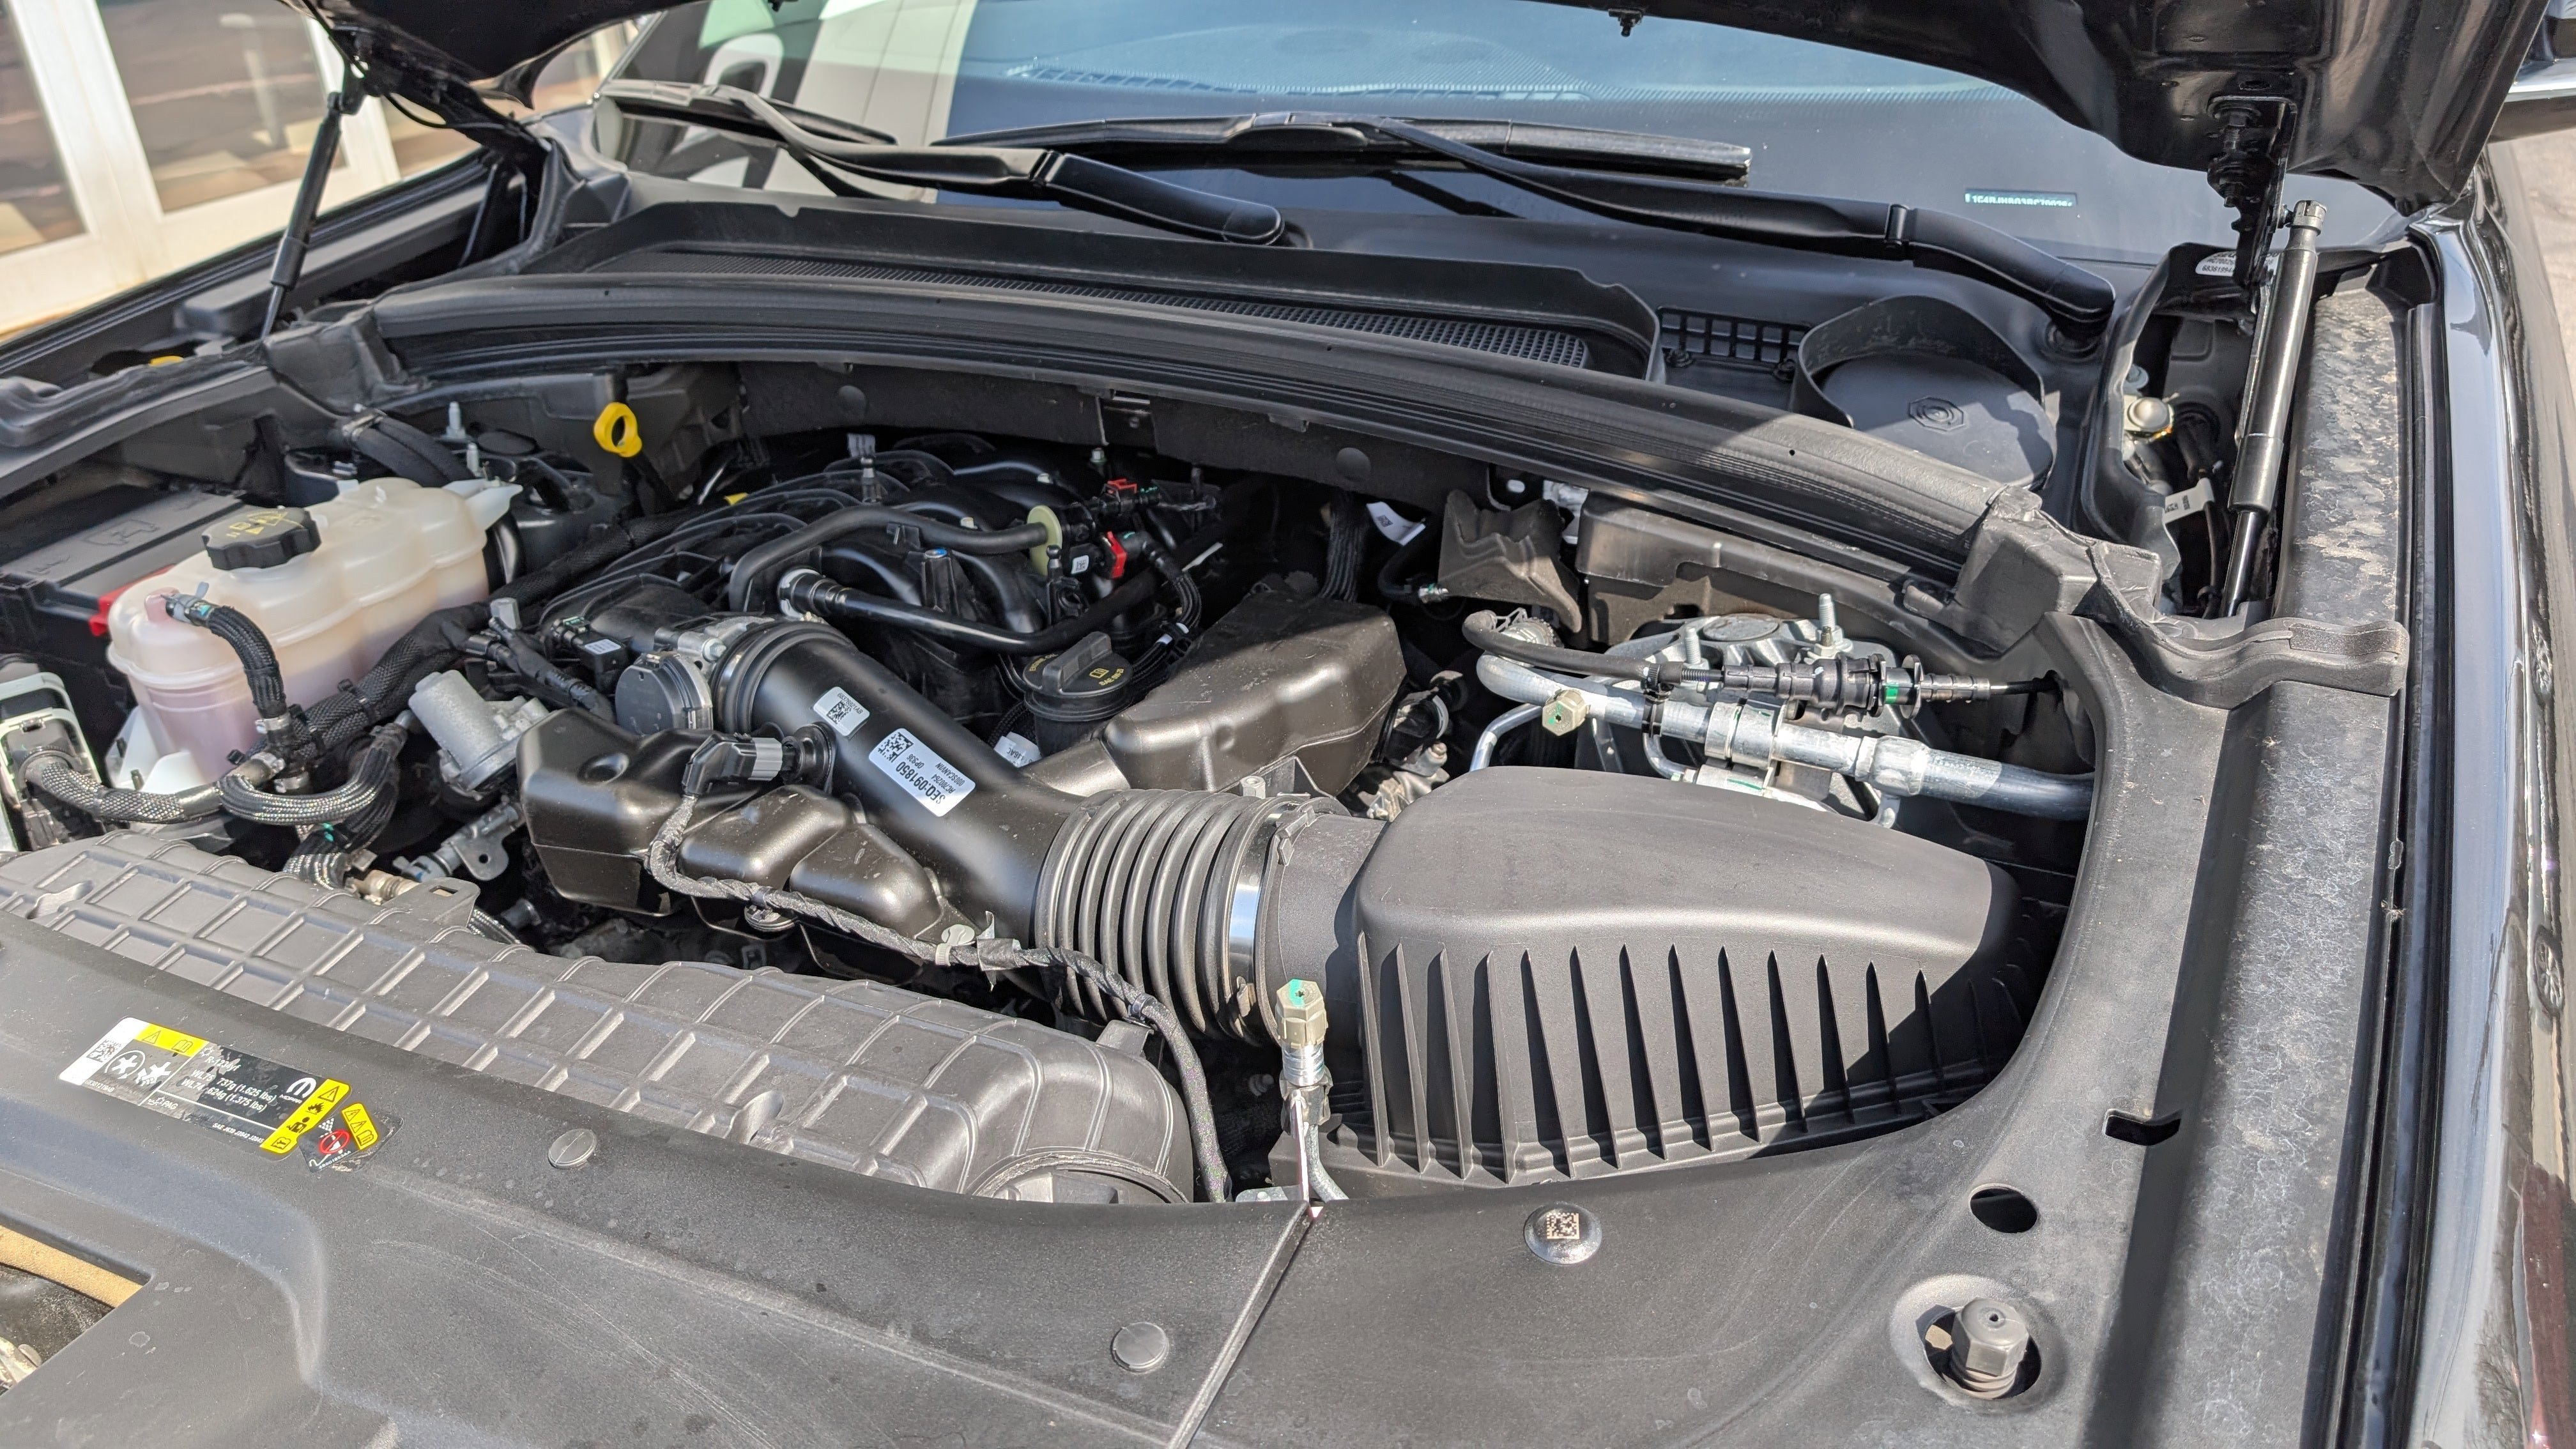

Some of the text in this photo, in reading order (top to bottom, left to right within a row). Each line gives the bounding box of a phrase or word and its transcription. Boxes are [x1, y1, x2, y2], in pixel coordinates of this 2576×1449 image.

[896, 761, 946, 804] SEQ:091850
[931, 774, 956, 794] RC700264
[204, 1055, 241, 1072] R-1234yf
[181, 1078, 268, 1113] WL74 624g (1.375 lbs)
[191, 1069, 277, 1103] WL75 737g (1.625 lbs)
[163, 1100, 179, 1110] PAG
[279, 1094, 303, 1105] MOPAR
